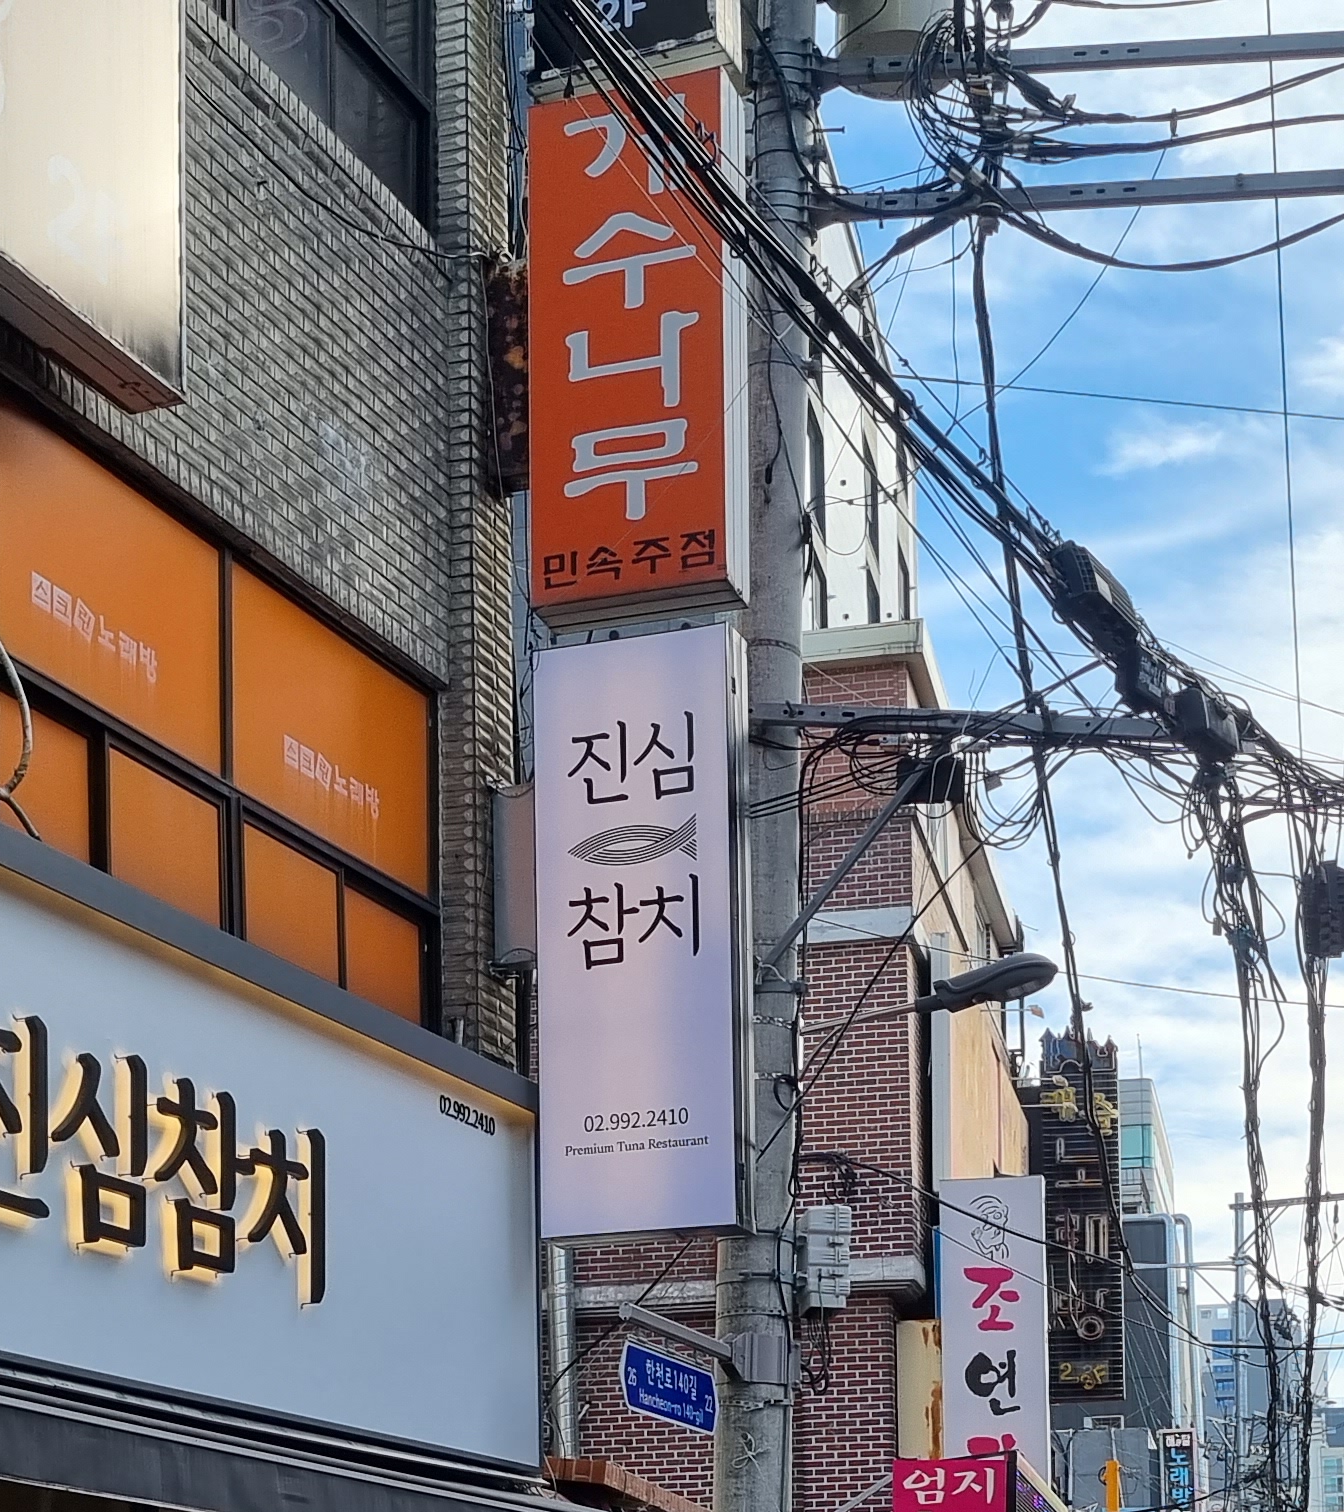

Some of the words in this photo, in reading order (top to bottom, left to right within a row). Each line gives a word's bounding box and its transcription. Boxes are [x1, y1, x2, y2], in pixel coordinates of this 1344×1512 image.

[542, 529, 717, 591] 민속주점
[566, 709, 696, 805] 진심
[566, 873, 701, 970] 참치
[438, 1093, 497, 1137] 02.992.2410
[583, 1106, 690, 1134] 02.992.2410
[564, 1143, 616, 1157] Premium
[617, 1141, 645, 1154] Tuna
[647, 1134, 710, 1153] Restaurant
[627, 1366, 637, 1387] 26
[645, 1358, 697, 1401] 한천로140길
[704, 1394, 714, 1414] 22
[963, 1266, 1021, 1456] 조연
[902, 1467, 996, 1505] 엄지
[1167, 1447, 1194, 1509] 노래방
